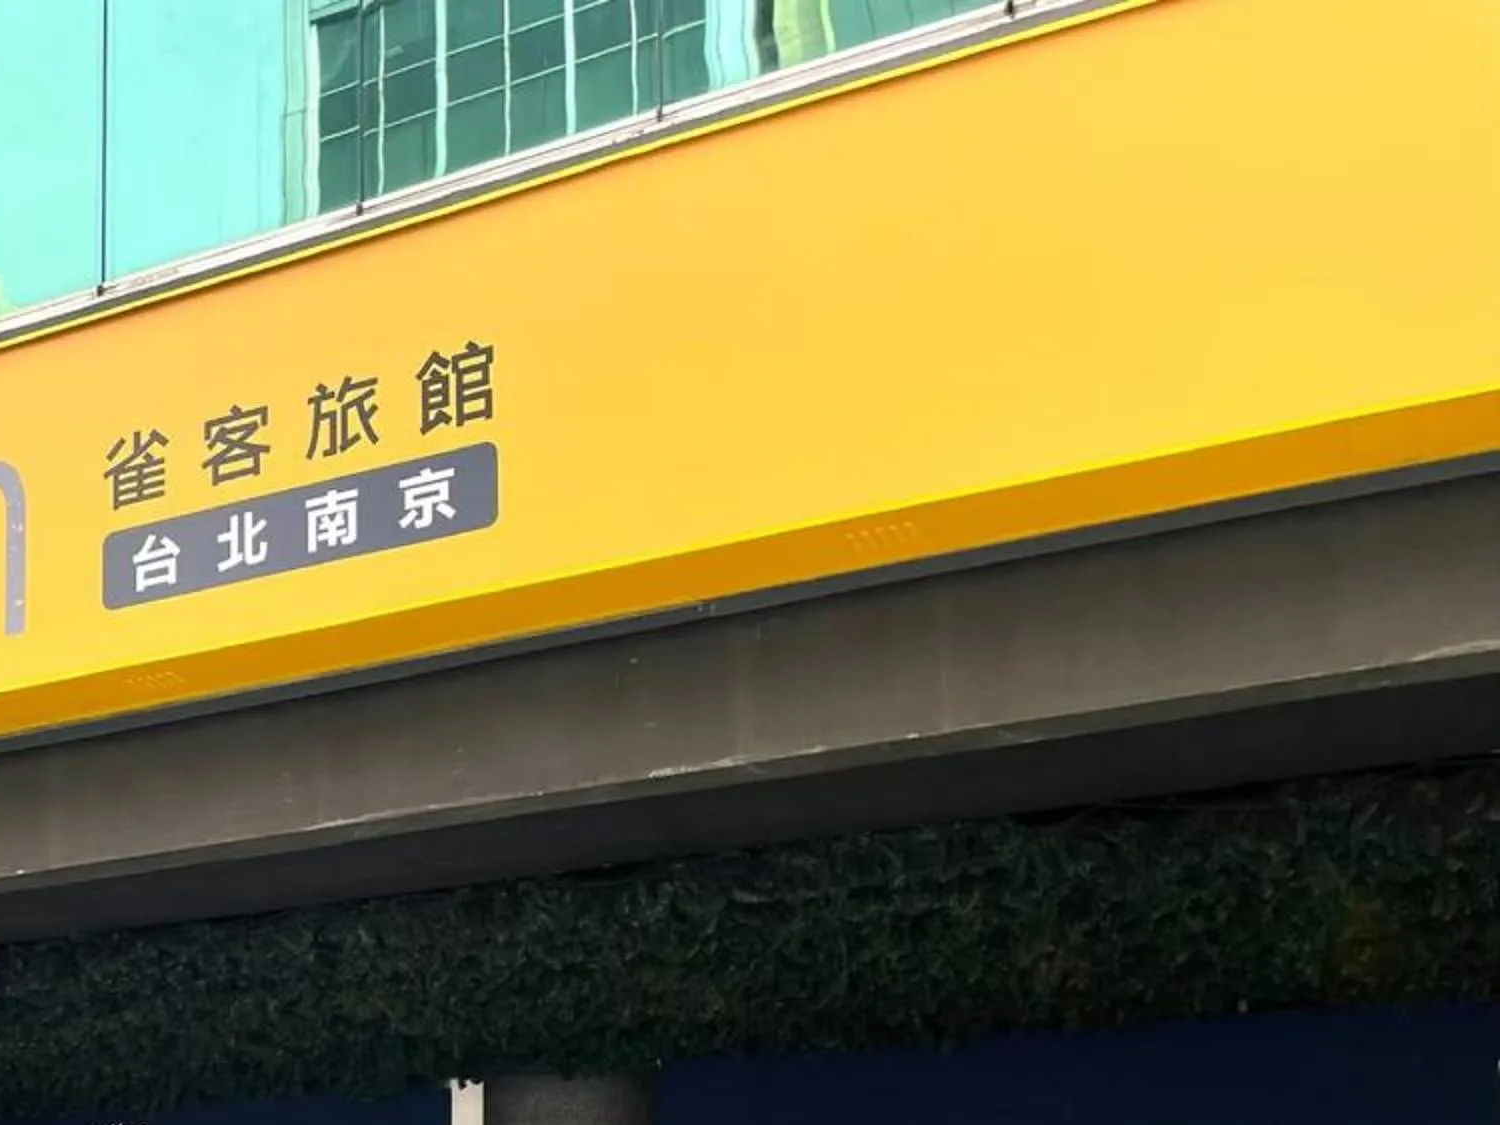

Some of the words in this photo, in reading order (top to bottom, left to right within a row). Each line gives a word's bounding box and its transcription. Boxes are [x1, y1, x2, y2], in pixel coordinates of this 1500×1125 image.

[103, 340, 496, 511] 雀客旅館
[130, 465, 460, 592] 台北南京
